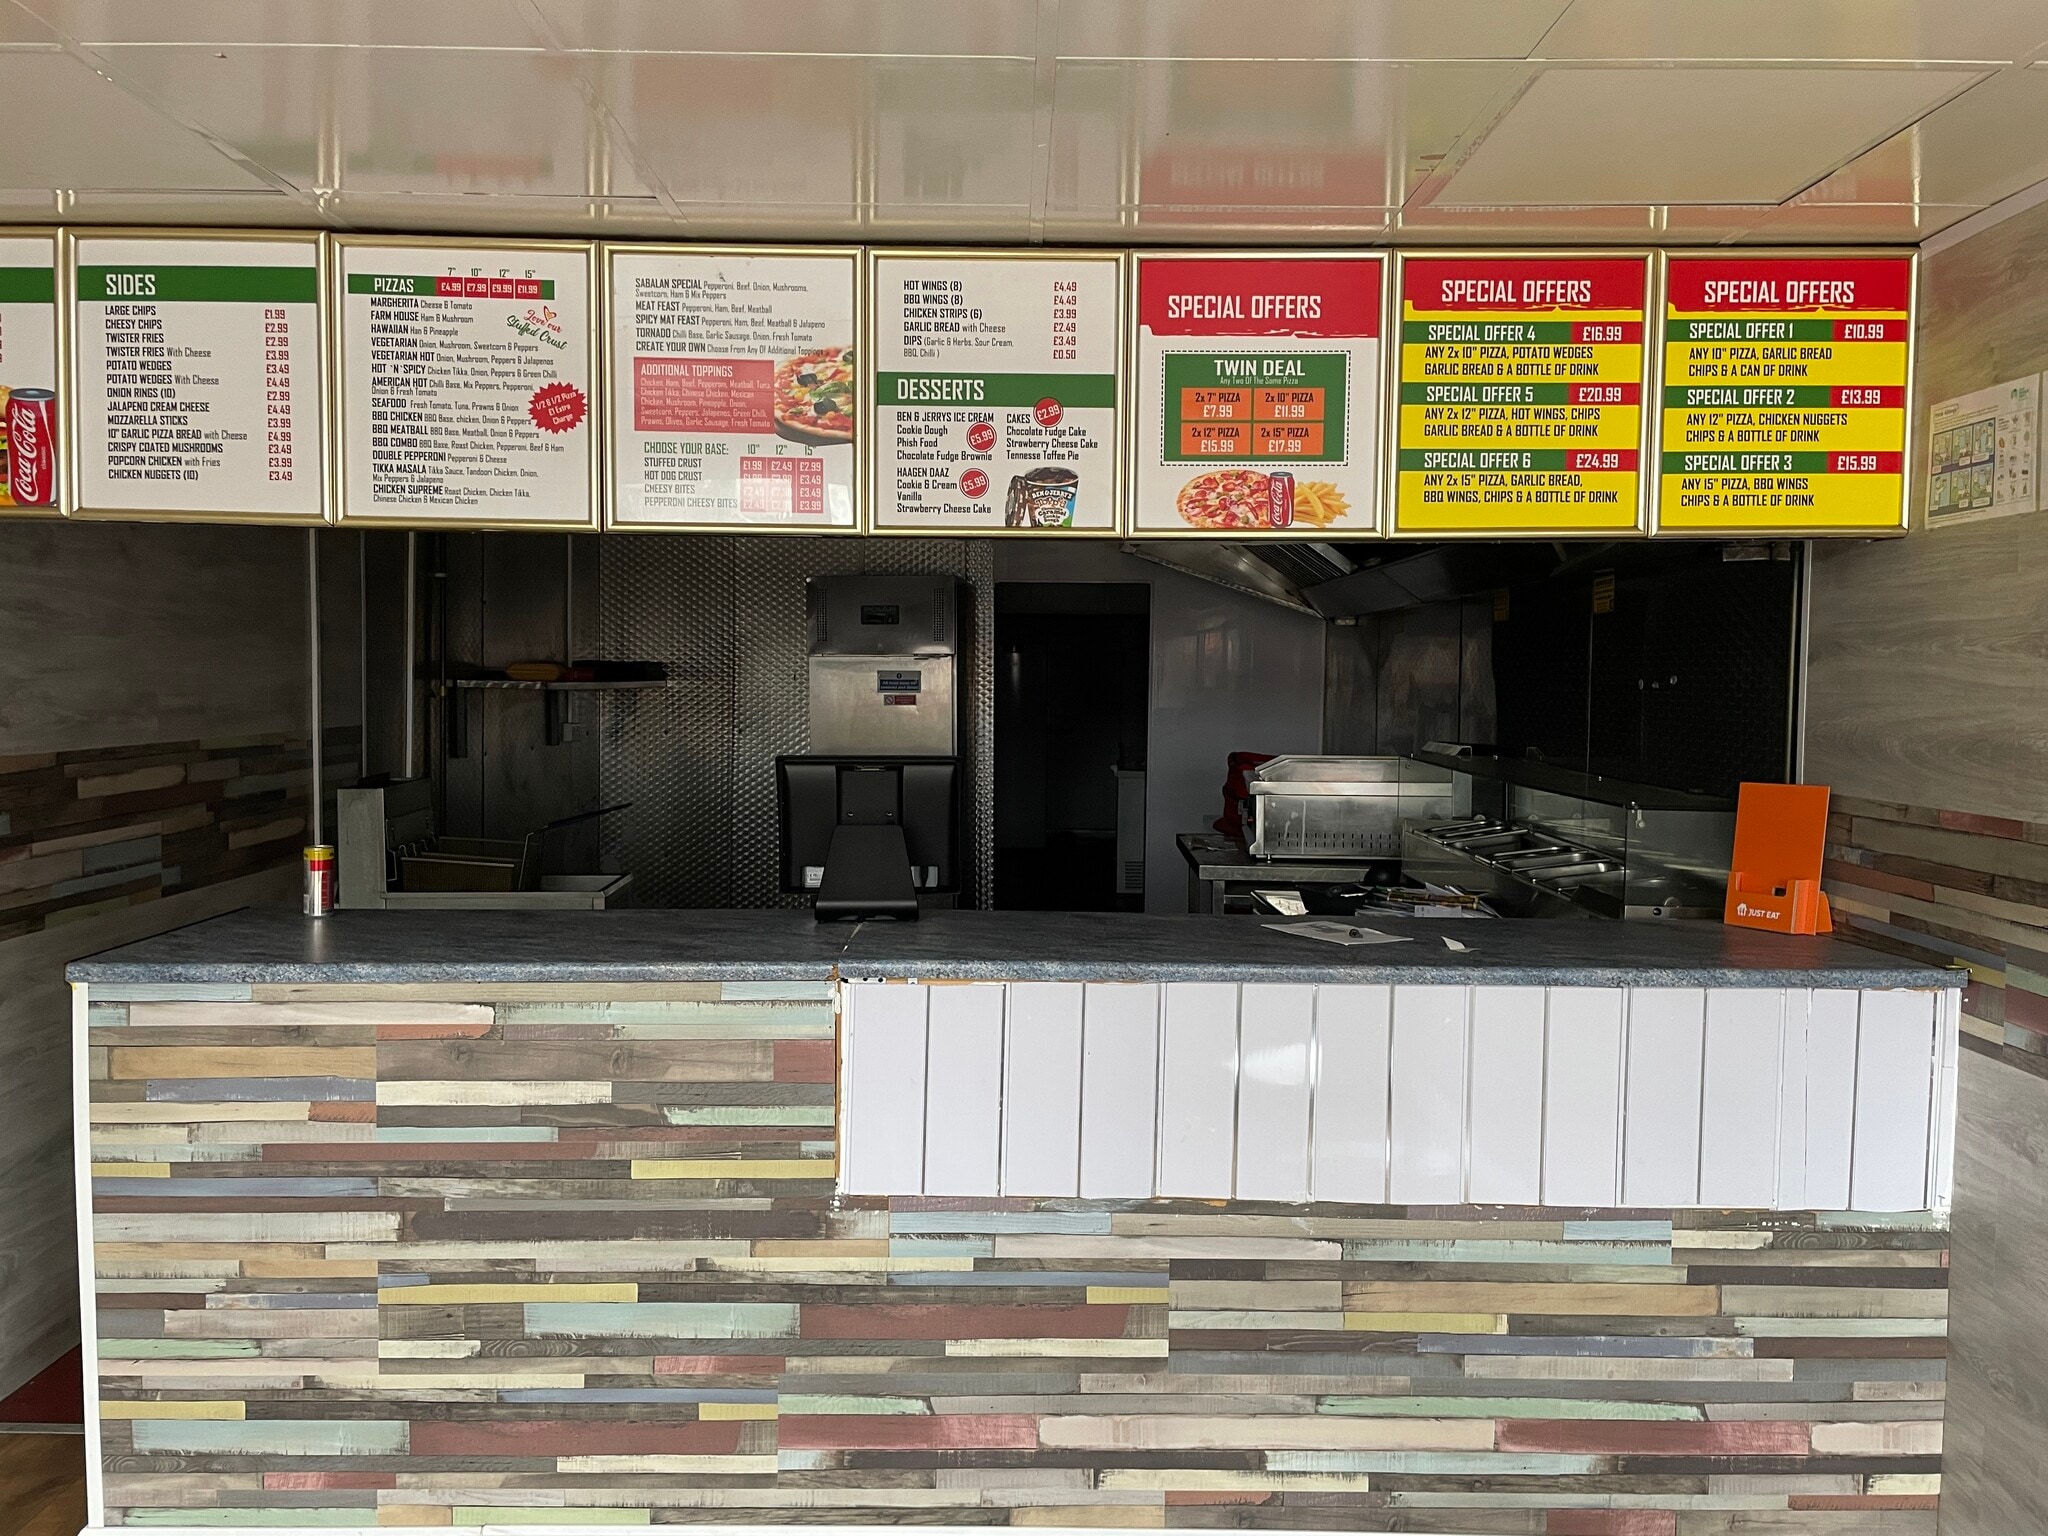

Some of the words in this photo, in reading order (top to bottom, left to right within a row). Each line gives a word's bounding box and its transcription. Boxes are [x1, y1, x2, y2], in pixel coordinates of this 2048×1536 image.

[106, 274, 155, 295] SIDES
[374, 278, 414, 292] PIZZAS
[442, 282, 461, 291] £4.99
[467, 283, 486, 292] £7.99
[492, 284, 512, 293] £9.99
[518, 285, 537, 294] £11.99
[904, 280, 919, 290] HOT
[922, 281, 947, 290] WINGS
[950, 281, 962, 292] (8)
[1054, 282, 1076, 291] £4.49
[1442, 280, 1516, 302] SPECIAL
[1523, 281, 1590, 302] OFFERS
[1705, 281, 1779, 302] SPECIAL
[1786, 281, 1854, 302] OFFERS
[371, 297, 419, 308] MARGHERITA
[421, 300, 442, 309] Cheese
[444, 300, 448, 309] &
[450, 300, 472, 310] Tomato
[636, 300, 655, 310] MEAT
[658, 301, 680, 311] FEAST
[1168, 296, 1244, 318] SPECIAL
[1252, 296, 1320, 318] OFFERS
[105, 306, 130, 315] LARGE
[132, 306, 156, 315] CHIPS
[265, 309, 285, 319] £1.99
[524, 309, 546, 326] Love
[547, 323, 563, 333] our
[506, 315, 538, 336] Stuffed
[540, 331, 567, 351] Crust
[1429, 325, 1480, 340] SPECIAL
[1485, 325, 1523, 341] OFFER
[1527, 326, 1535, 340] 4
[1583, 326, 1621, 341] £16.99
[1690, 323, 1742, 338] SPECIAL
[1746, 323, 1784, 338] OFFER
[1790, 323, 1793, 338] 1
[1844, 324, 1883, 338] £10.99
[106, 347, 140, 356] TWISTER
[142, 347, 164, 356] FRIES
[167, 347, 182, 357] With
[185, 347, 211, 357] Cheese
[266, 350, 289, 360] £3.99
[1425, 346, 1444, 358] ANY
[1448, 346, 1459, 358] 2x
[1480, 347, 1509, 359] PIZZA,
[1513, 347, 1550, 358] POTATO
[1554, 347, 1593, 358] WEDGES
[1689, 348, 1709, 360] ANY
[1730, 348, 1759, 360] PIZZA,
[1763, 348, 1796, 359] GARLIC
[1800, 348, 1832, 359] BREAD
[641, 364, 689, 376] ADDITIONAL
[692, 365, 732, 377] TOPPINGS
[1214, 360, 1256, 376] TWIN
[1263, 360, 1305, 376] DEAL
[1220, 376, 1230, 386] Any
[1246, 376, 1252, 384] Of
[107, 388, 132, 397] ONION
[134, 388, 158, 398] RINGS
[161, 388, 175, 399] (10)
[267, 391, 290, 401] £2.99
[898, 379, 984, 400] DESSERTS
[1427, 386, 1478, 402] SPECIAL
[1483, 386, 1521, 402] OFFER
[1526, 387, 1533, 402] 5
[1579, 388, 1621, 402] £20.99
[1196, 392, 1204, 402] 2x
[1219, 393, 1240, 402] PIZZA
[1266, 393, 1274, 402] 2x
[1292, 393, 1313, 402] PIZZA
[1688, 389, 1739, 404] SPECIAL
[1744, 389, 1782, 404] OFFER
[1786, 389, 1794, 404] 2
[1842, 390, 1880, 404] £13.99
[897, 412, 912, 421] BEN
[914, 412, 919, 421] &
[922, 412, 951, 422] JERRYS
[954, 412, 965, 422] ICE
[968, 412, 994, 423] CREAM
[1007, 414, 1030, 424] CAKES
[1036, 405, 1060, 420] £2.99
[1204, 405, 1232, 417] £7.99
[1275, 405, 1304, 417] £11.99
[108, 415, 158, 425] MOZZARELLA
[160, 416, 188, 425] STICKS
[268, 418, 291, 428] £3.99
[970, 429, 994, 445] £5.99
[1192, 428, 1201, 437] 2x
[1218, 428, 1239, 437] PIZZA
[1261, 428, 1270, 437] 2x
[1288, 428, 1309, 437] PIZZA
[644, 442, 677, 454] CHOOSE
[680, 443, 702, 454] YOUR
[705, 443, 728, 455] BASE:
[1201, 440, 1233, 452] £15.99
[1269, 440, 1301, 452] £17.99
[373, 450, 402, 460] DOUBLE
[404, 451, 446, 461] PEPPERONI
[480, 454, 484, 462] &
[486, 454, 507, 463] Cheese
[1006, 450, 1040, 460] Tennesse
[1043, 451, 1066, 461] Toffee
[1068, 450, 1079, 460] Pie
[1424, 453, 1476, 468] SPECIAL
[1480, 453, 1518, 468] OFFER
[1523, 453, 1530, 468] 6
[1576, 454, 1618, 468] £24.99
[644, 457, 676, 467] STUFFED
[678, 458, 702, 468] CRUST
[744, 461, 762, 470] £1.99
[771, 461, 792, 471] £2.49
[800, 462, 820, 471] £2.99
[1685, 455, 1736, 470] SPECIAL
[1741, 455, 1779, 470] OFFER
[1784, 455, 1792, 470] 3
[1838, 456, 1876, 470] £15.99
[109, 469, 142, 479] CHICKEN
[145, 470, 180, 480] NUGGETS
[183, 470, 198, 480] (10)
[269, 471, 292, 480] £3.49
[897, 468, 927, 477] HAAGEN
[930, 468, 949, 477] DAAZ
[962, 475, 986, 491] £5.99
[897, 492, 922, 501] Vanilla
[1748, 909, 1765, 917] JUST
